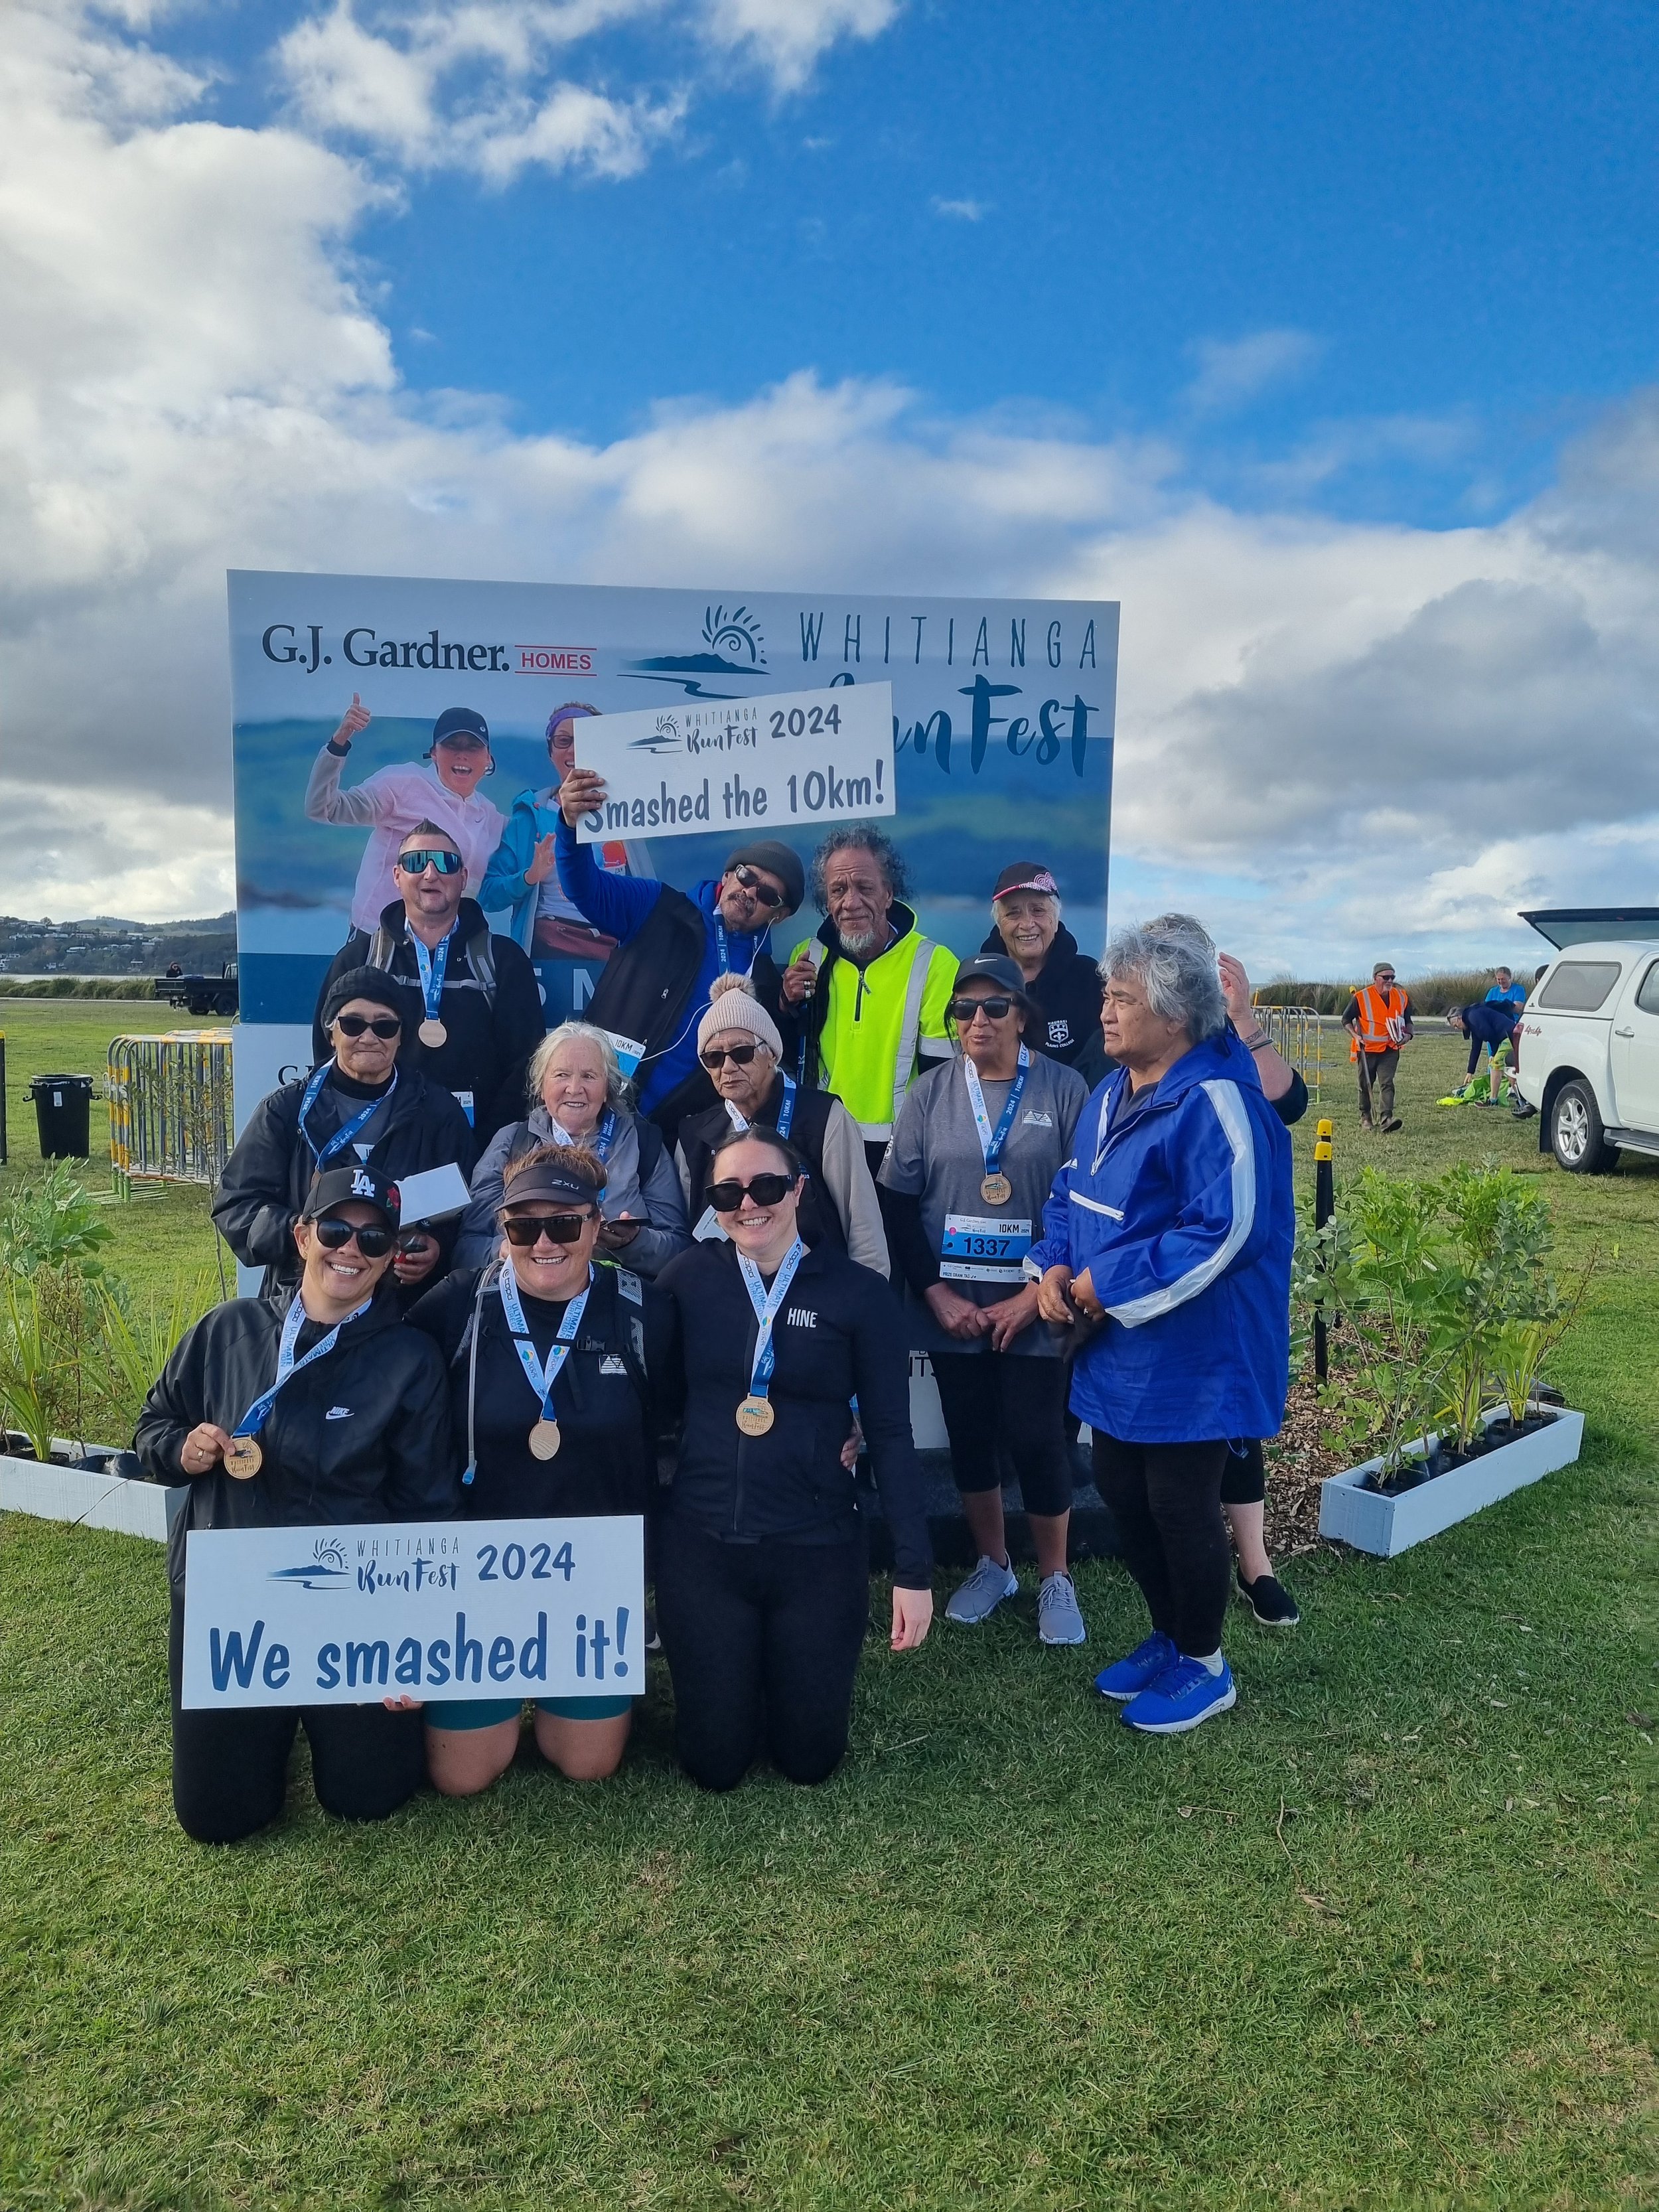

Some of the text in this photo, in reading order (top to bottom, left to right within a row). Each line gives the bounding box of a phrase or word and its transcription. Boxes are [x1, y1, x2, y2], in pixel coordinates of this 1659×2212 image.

[261, 624, 510, 674] G.J. Gardner.
[800, 612, 1096, 669] WHITIANGA
[521, 652, 592, 670] HOMES
[685, 707, 757, 728] WHITIANGA
[769, 704, 841, 739] 2024
[723, 773, 768, 820] the
[787, 759, 885, 814] 10km!
[614, 1039, 633, 1052] 10KM
[1059, 1038, 1075, 1048] COLLEGE
[1005, 1075, 1025, 1115] 2024 10KM
[357, 1108, 372, 1121] 2024
[782, 1099, 792, 1117] 10KM
[598, 1142, 607, 1157] 2024
[351, 1169, 375, 1197] LA
[999, 1224, 1019, 1234] 10KM
[964, 1236, 1011, 1256] 1337
[772, 1274, 791, 1309] ULTIMATE
[559, 1300, 577, 1339] DIRECTION
[564, 1301, 584, 1339] ULTIMATE
[786, 1307, 818, 1328] HINE
[286, 1327, 298, 1366] ULTIMATE
[330, 1406, 350, 1415] NIKE
[356, 1536, 461, 1558] WHITIANGA
[476, 1542, 576, 1582] 2024
[210, 1606, 630, 1692] We smashed it!
